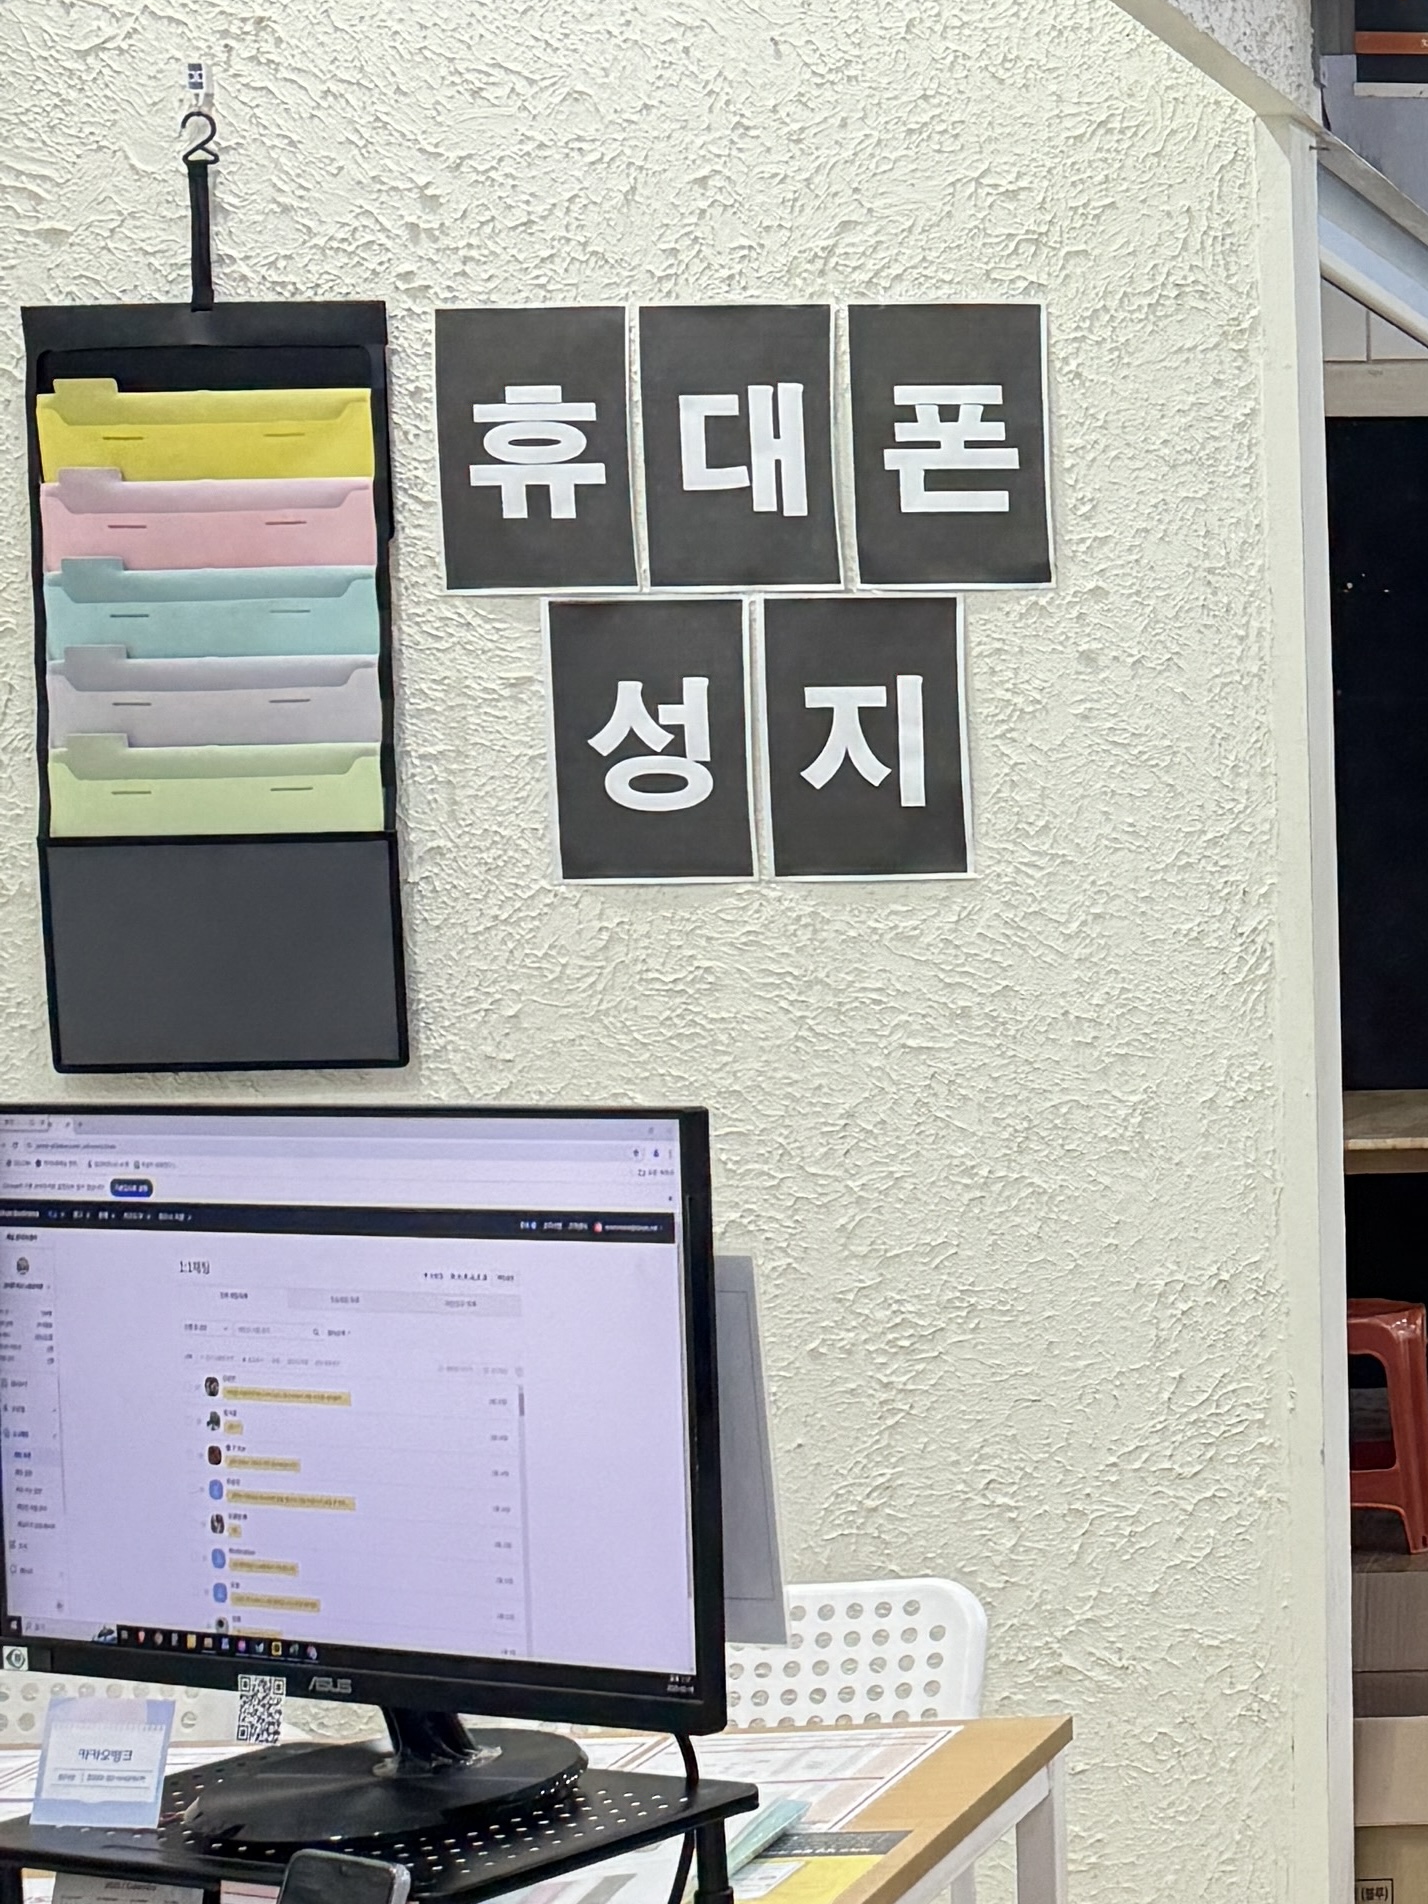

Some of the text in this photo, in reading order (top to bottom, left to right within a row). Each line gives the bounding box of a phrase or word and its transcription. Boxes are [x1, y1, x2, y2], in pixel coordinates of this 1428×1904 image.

[468, 382, 1020, 520] 휴대폰
[586, 674, 927, 813] 성지
[308, 1676, 352, 1694] ASUS
